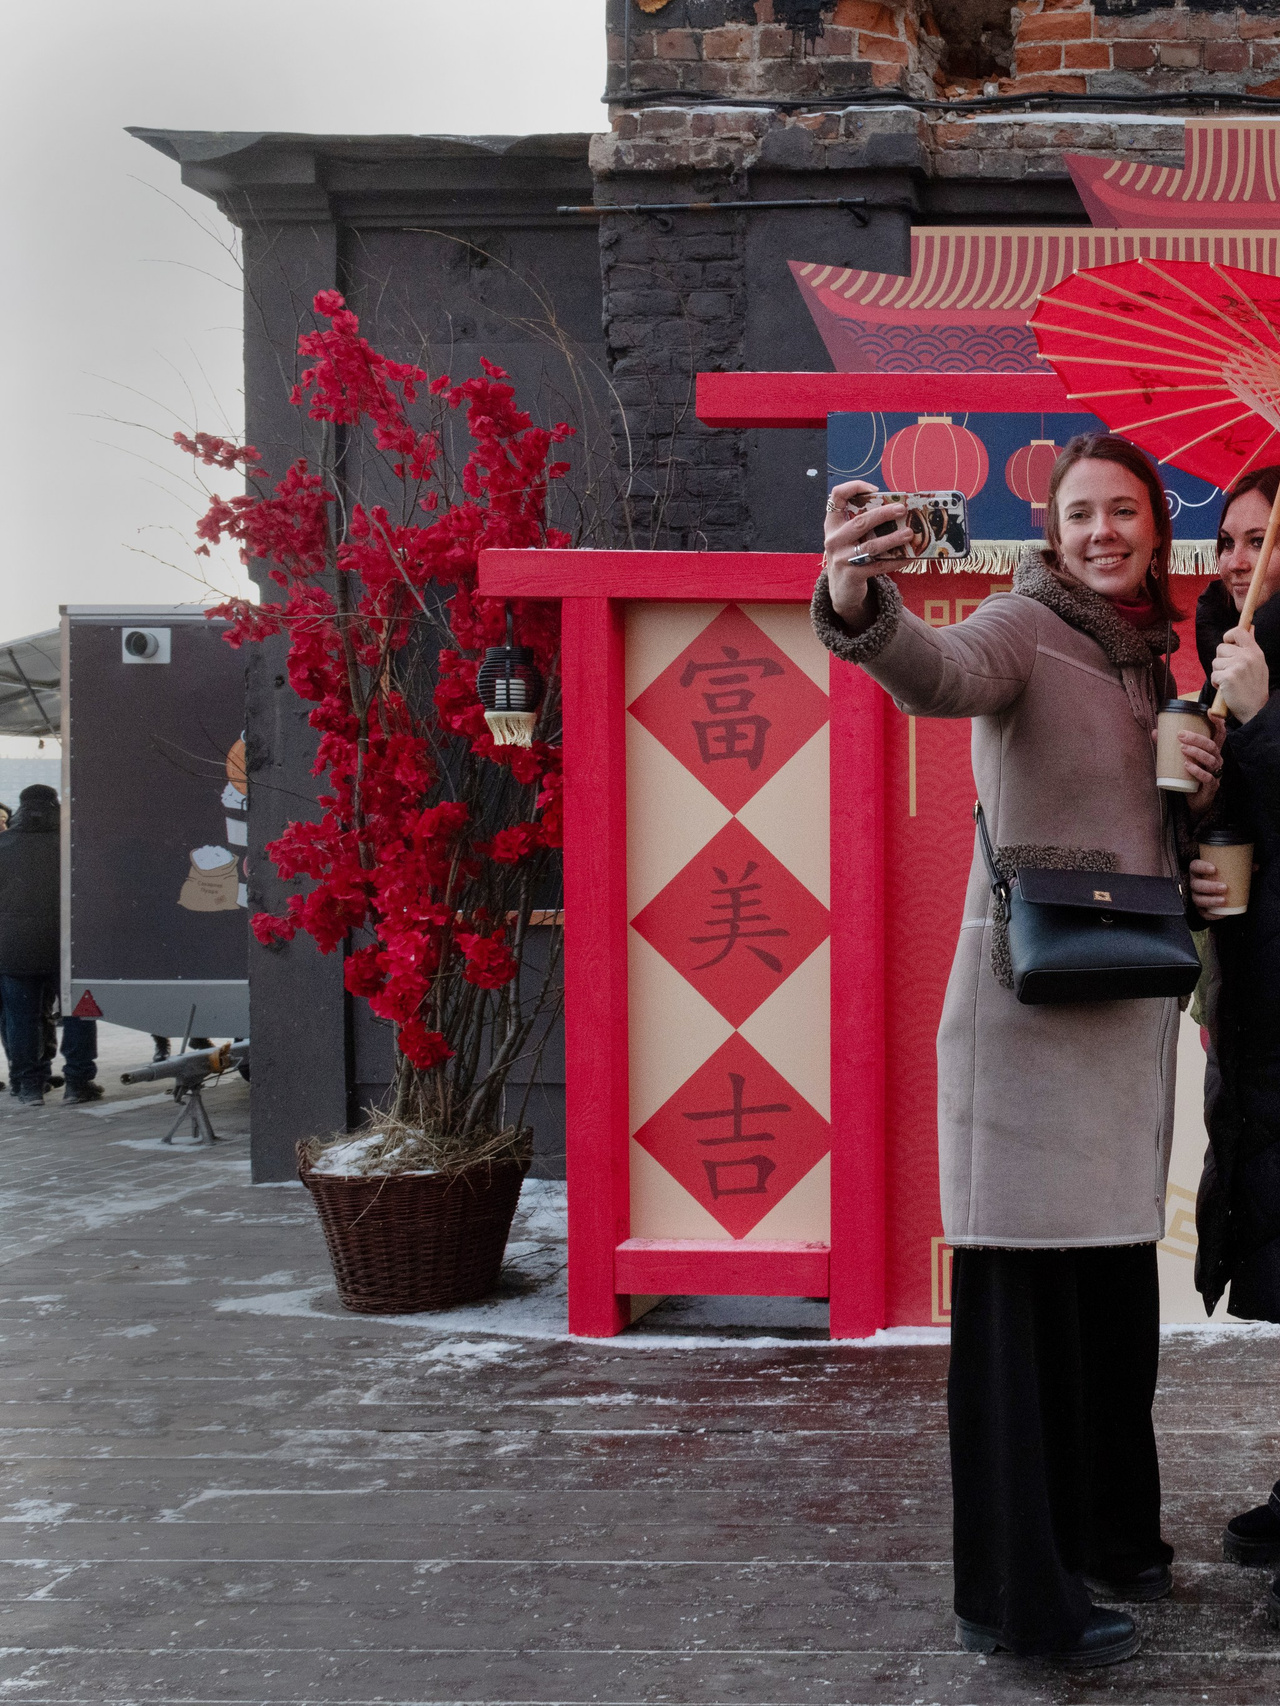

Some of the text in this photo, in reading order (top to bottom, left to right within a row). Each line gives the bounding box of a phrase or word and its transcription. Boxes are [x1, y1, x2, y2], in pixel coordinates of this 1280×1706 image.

[680, 646, 785, 771] 富
[689, 860, 790, 973] 美
[682, 1072, 791, 1201] 吉
